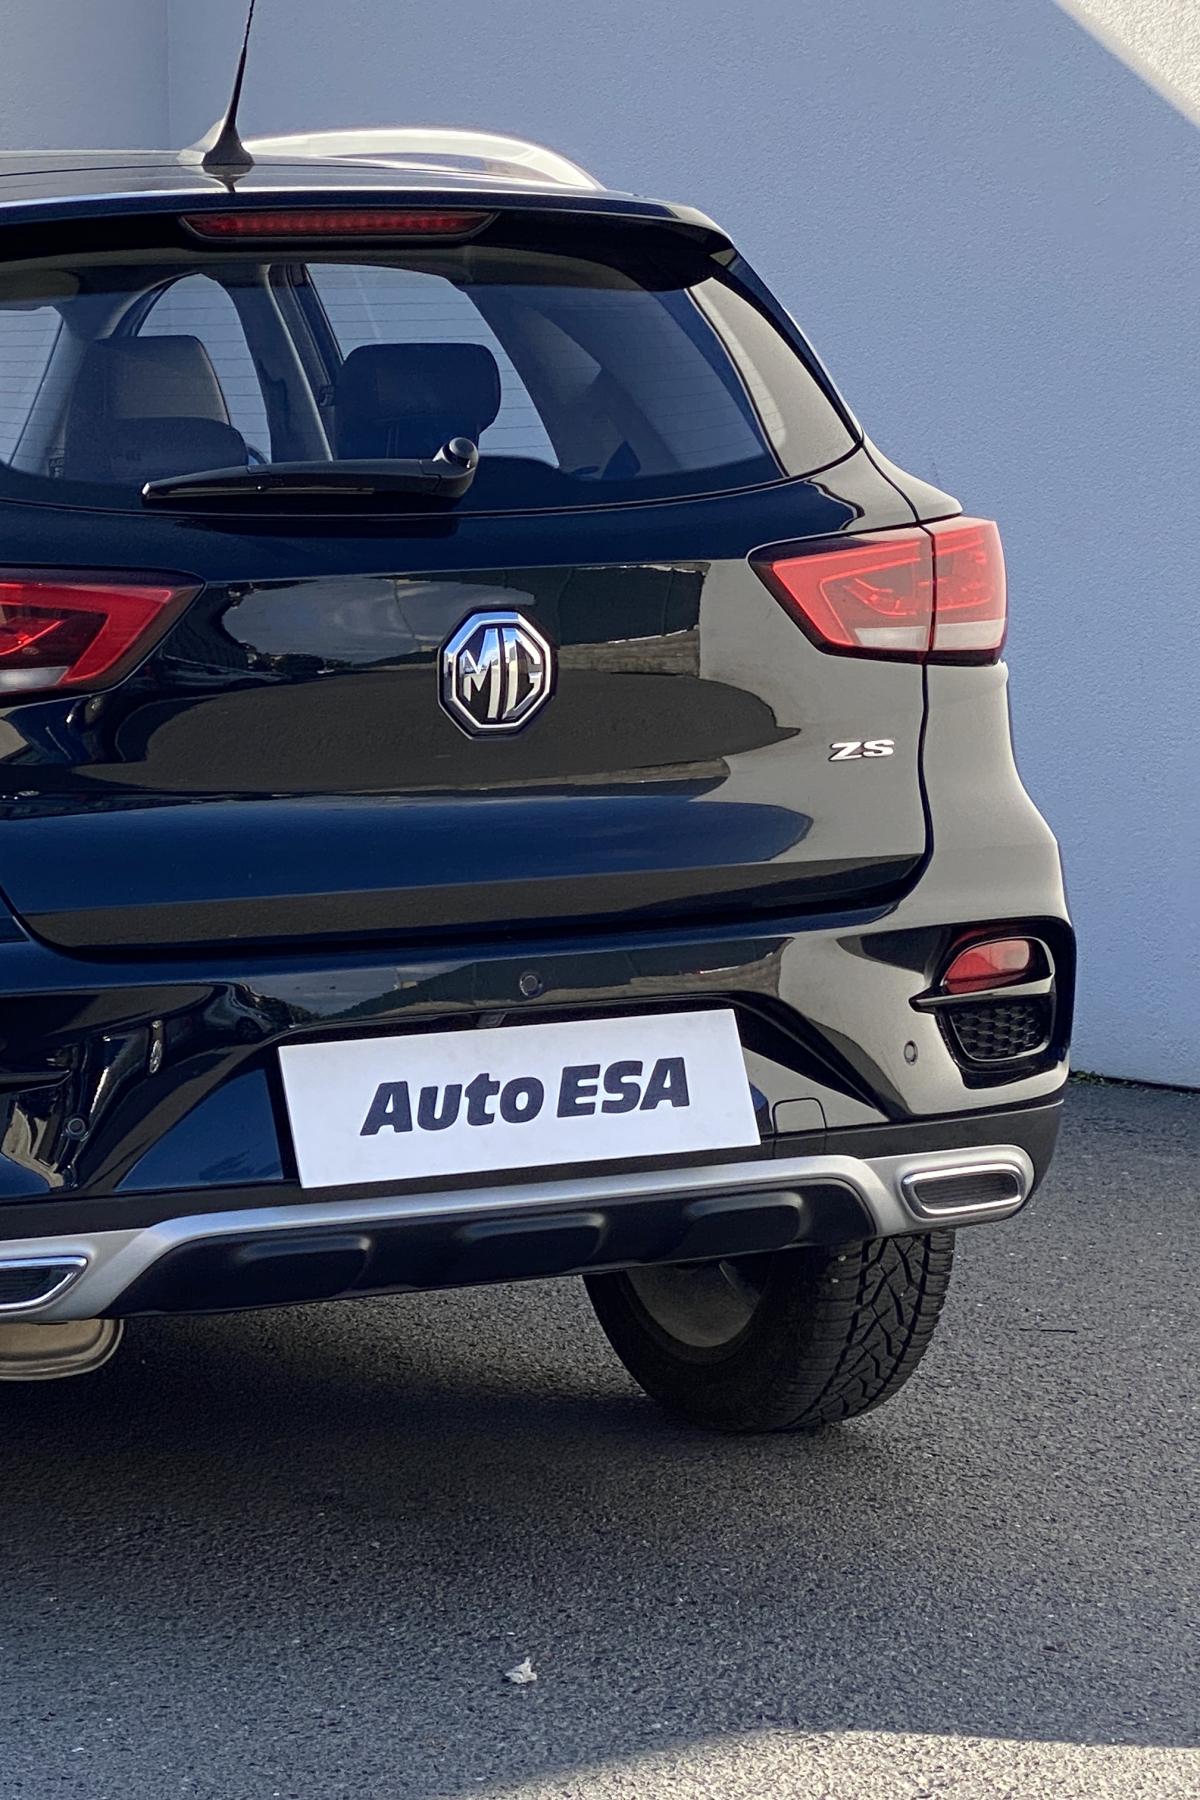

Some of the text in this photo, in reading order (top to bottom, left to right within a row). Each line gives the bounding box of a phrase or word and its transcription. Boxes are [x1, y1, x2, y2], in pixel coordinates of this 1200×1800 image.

[457, 626, 544, 721] MG
[827, 739, 895, 762] ZS
[359, 1056, 691, 1137] Auto ESA
